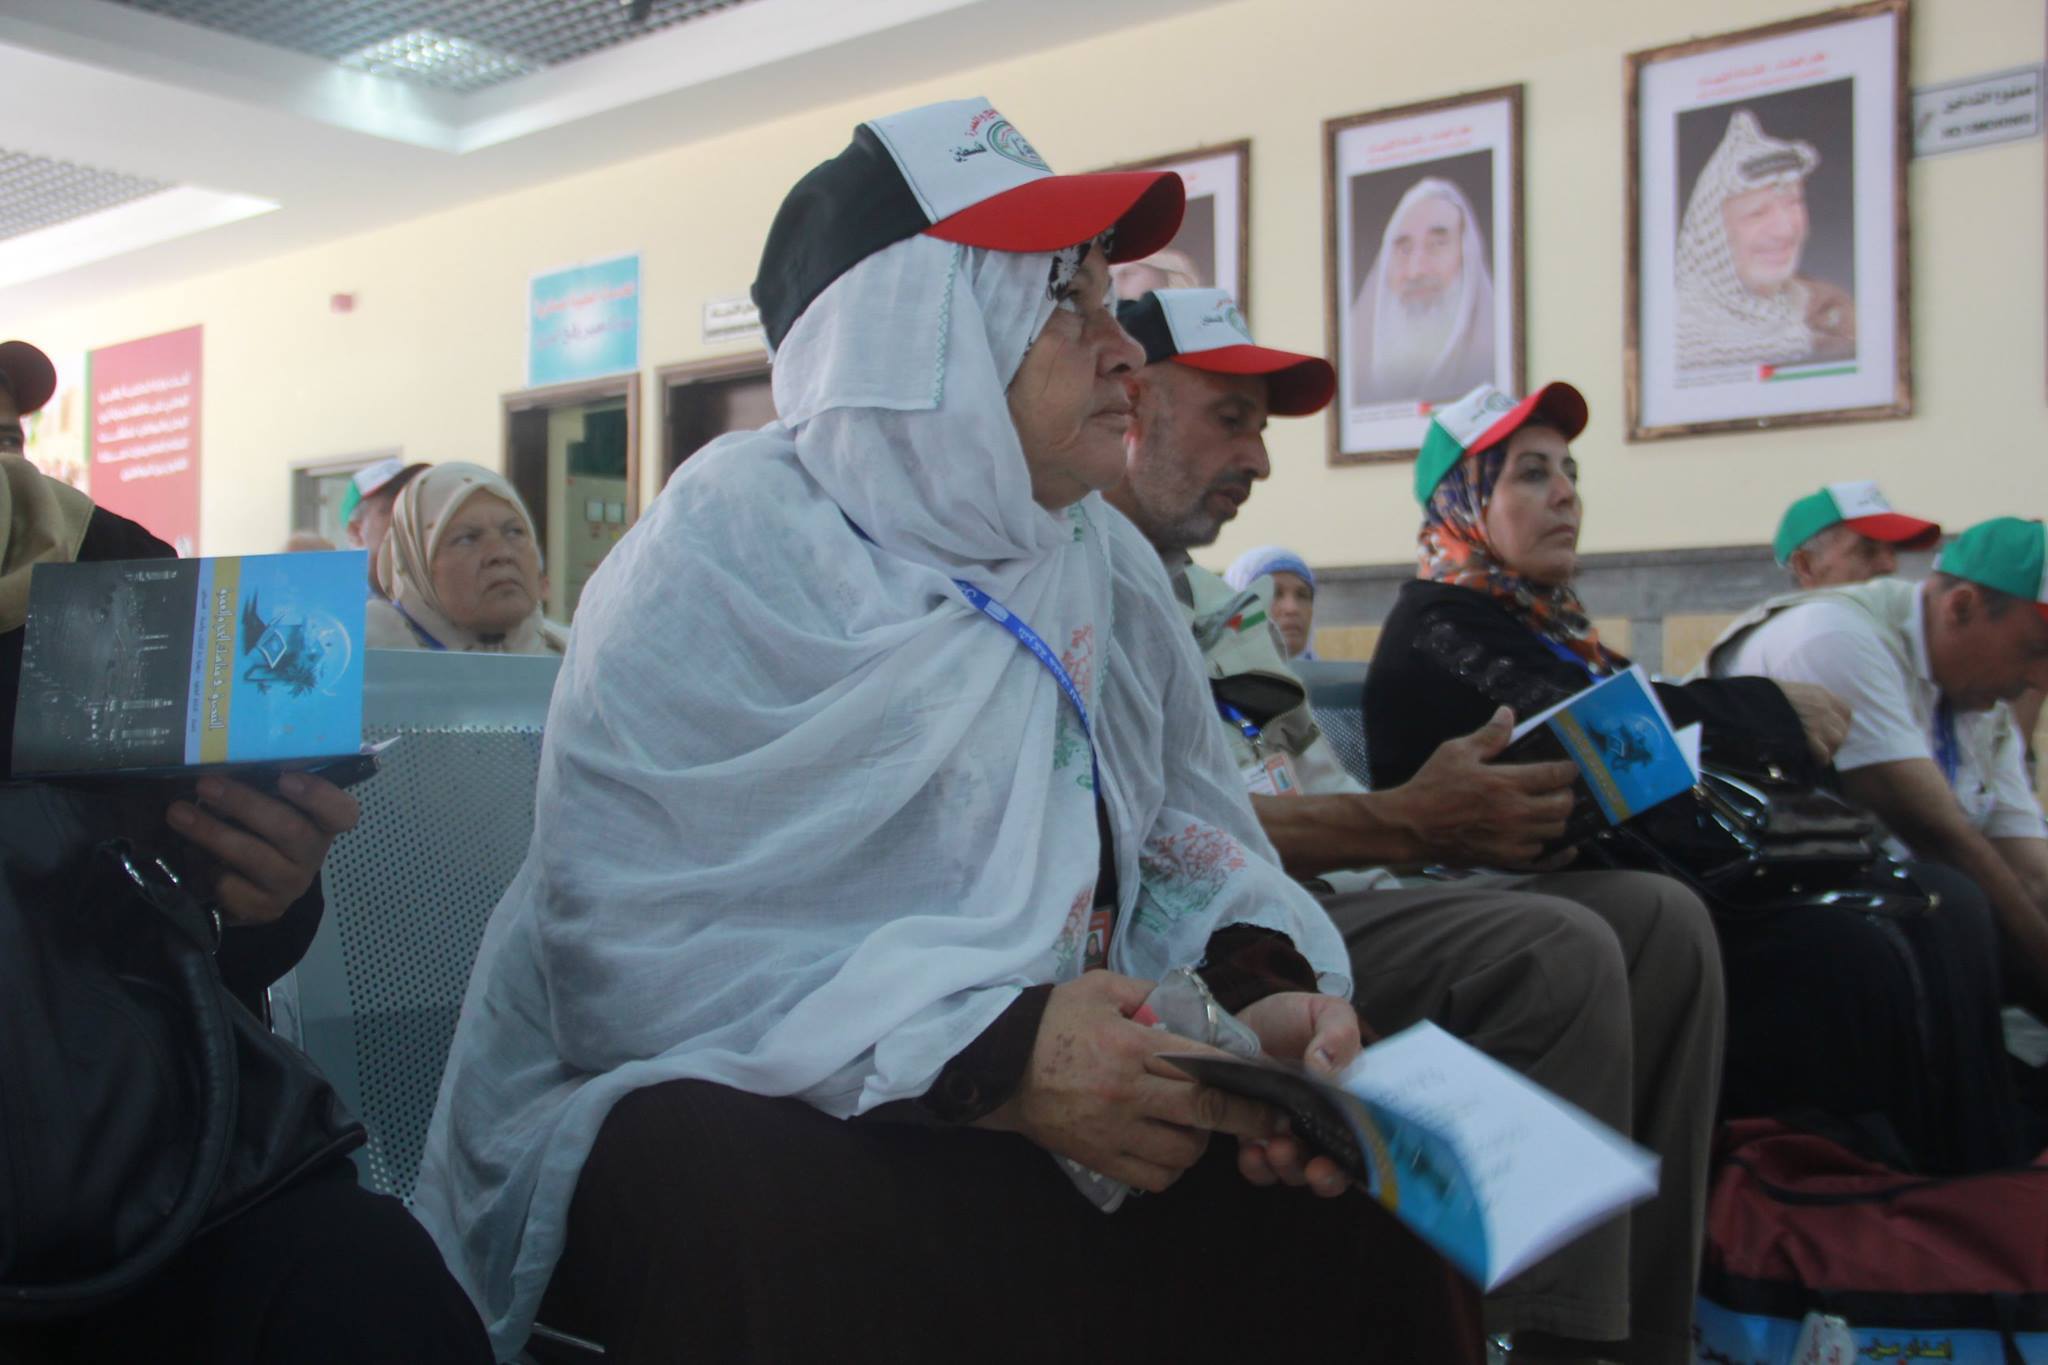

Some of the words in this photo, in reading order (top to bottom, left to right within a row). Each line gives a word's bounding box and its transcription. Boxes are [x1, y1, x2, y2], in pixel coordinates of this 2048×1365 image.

[213, 588, 234, 622] والعمرة
[212, 623, 232, 641] الحج
[212, 644, 230, 676] مناسك
